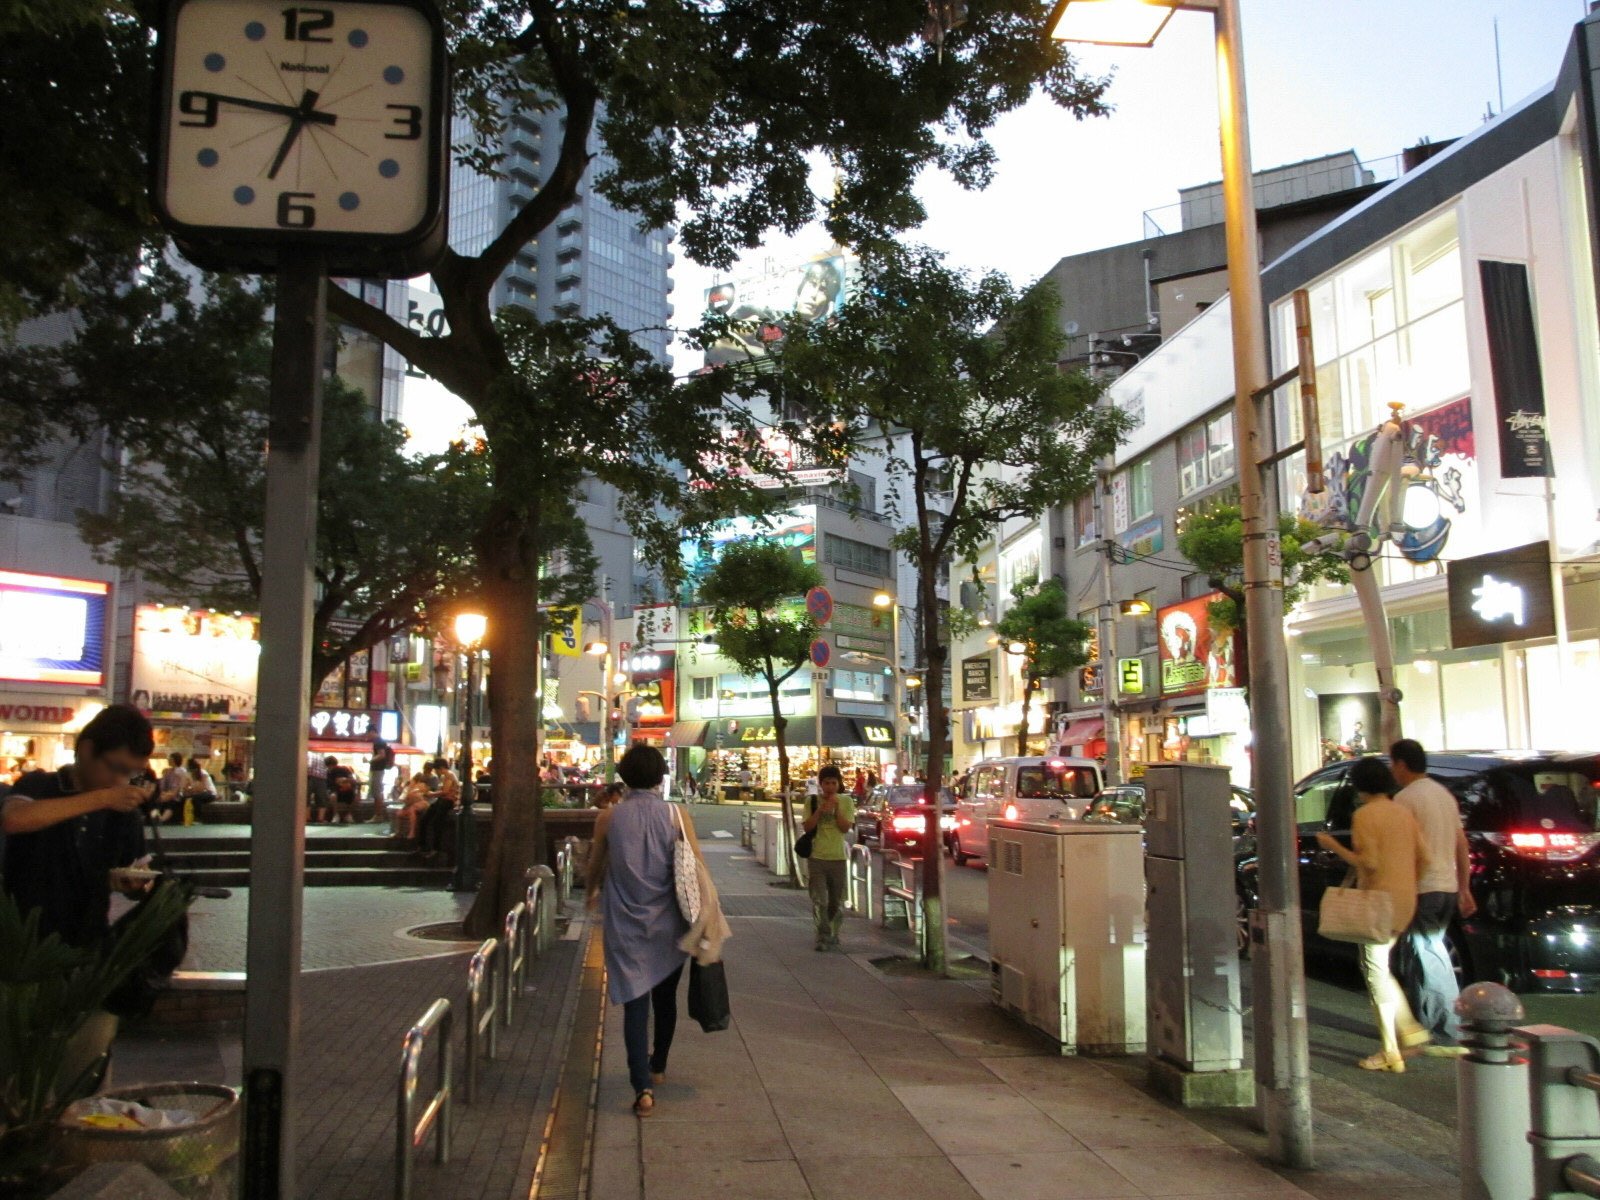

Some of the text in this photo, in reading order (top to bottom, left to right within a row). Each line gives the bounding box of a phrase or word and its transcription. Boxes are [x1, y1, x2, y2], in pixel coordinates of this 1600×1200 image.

[281, 8, 334, 43] 12
[280, 61, 330, 74] National
[179, 91, 219, 128] 9
[384, 104, 422, 141] 3
[276, 191, 316, 229] 6
[966, 677, 987, 685] MARKET
